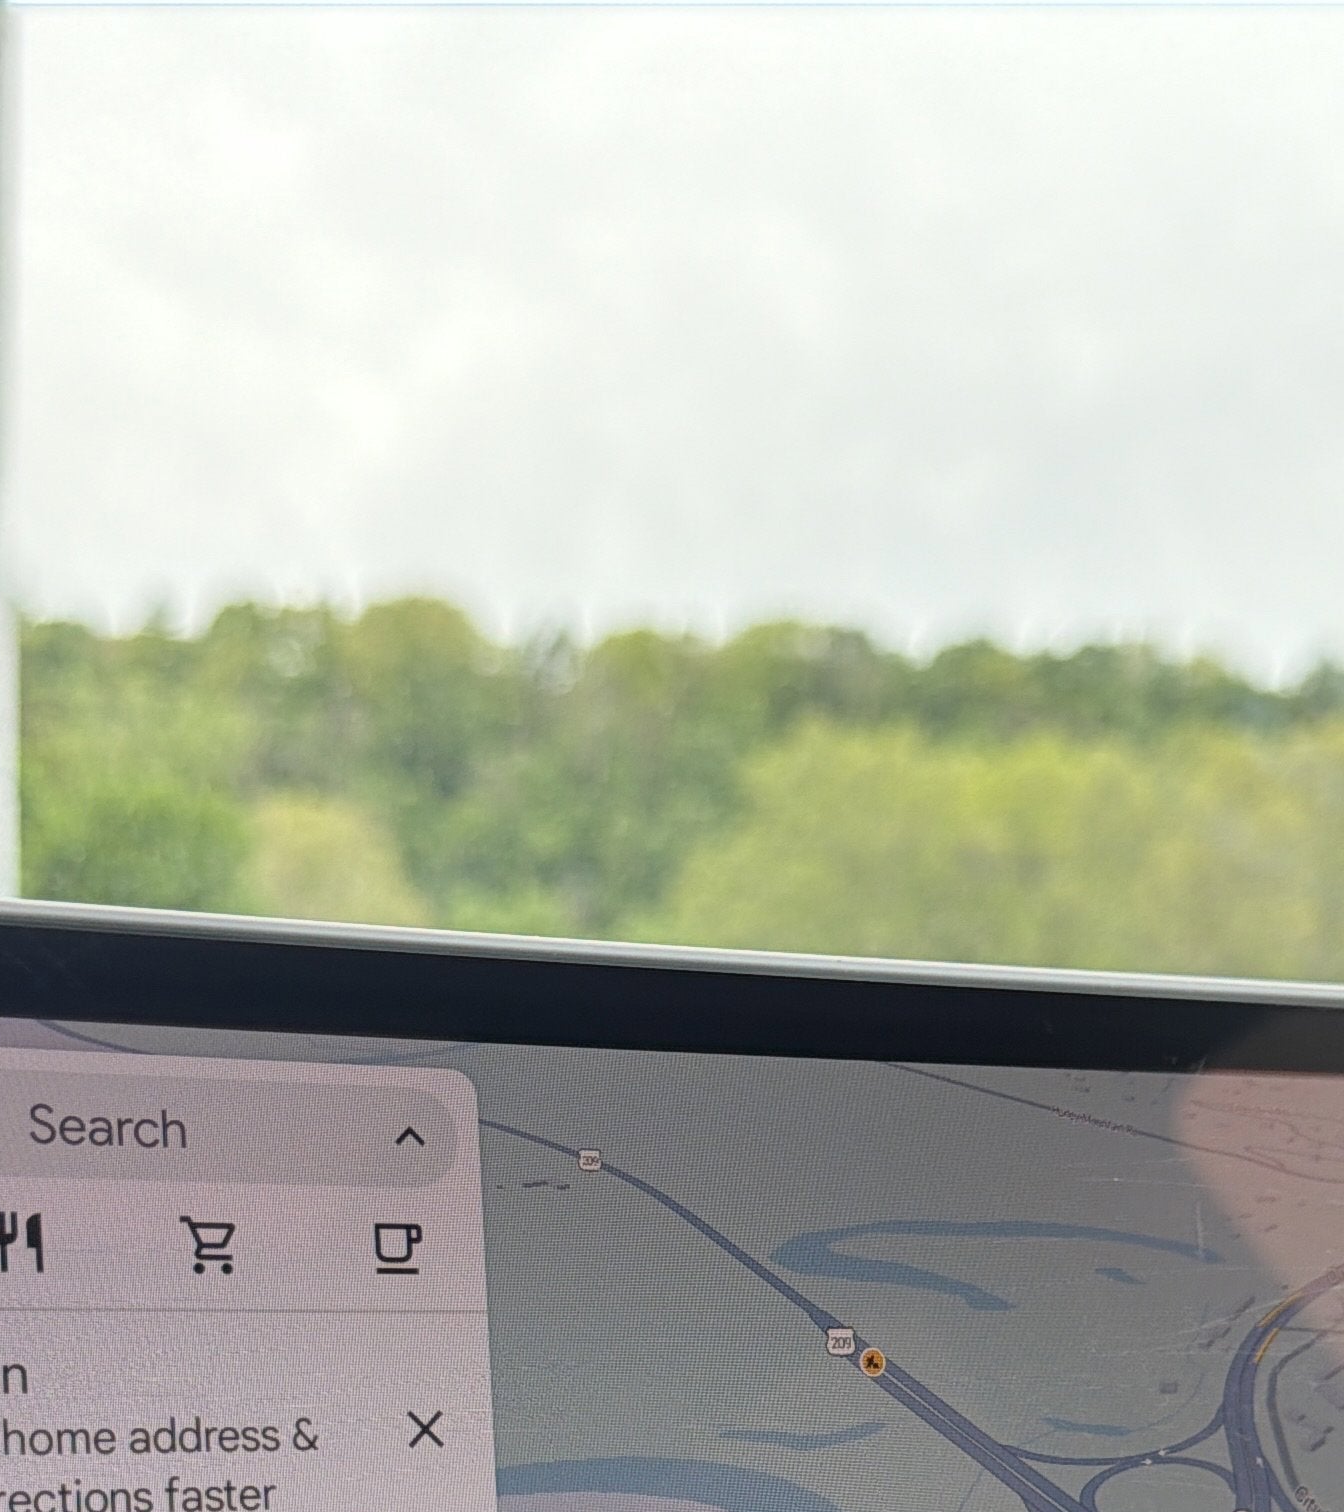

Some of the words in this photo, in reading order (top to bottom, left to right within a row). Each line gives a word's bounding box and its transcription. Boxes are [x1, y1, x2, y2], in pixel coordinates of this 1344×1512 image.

[29, 1102, 187, 1149] Search
[830, 1336, 852, 1350] 209
[2, 1417, 117, 1456] home
[129, 1415, 281, 1454] address
[292, 1417, 319, 1452] &
